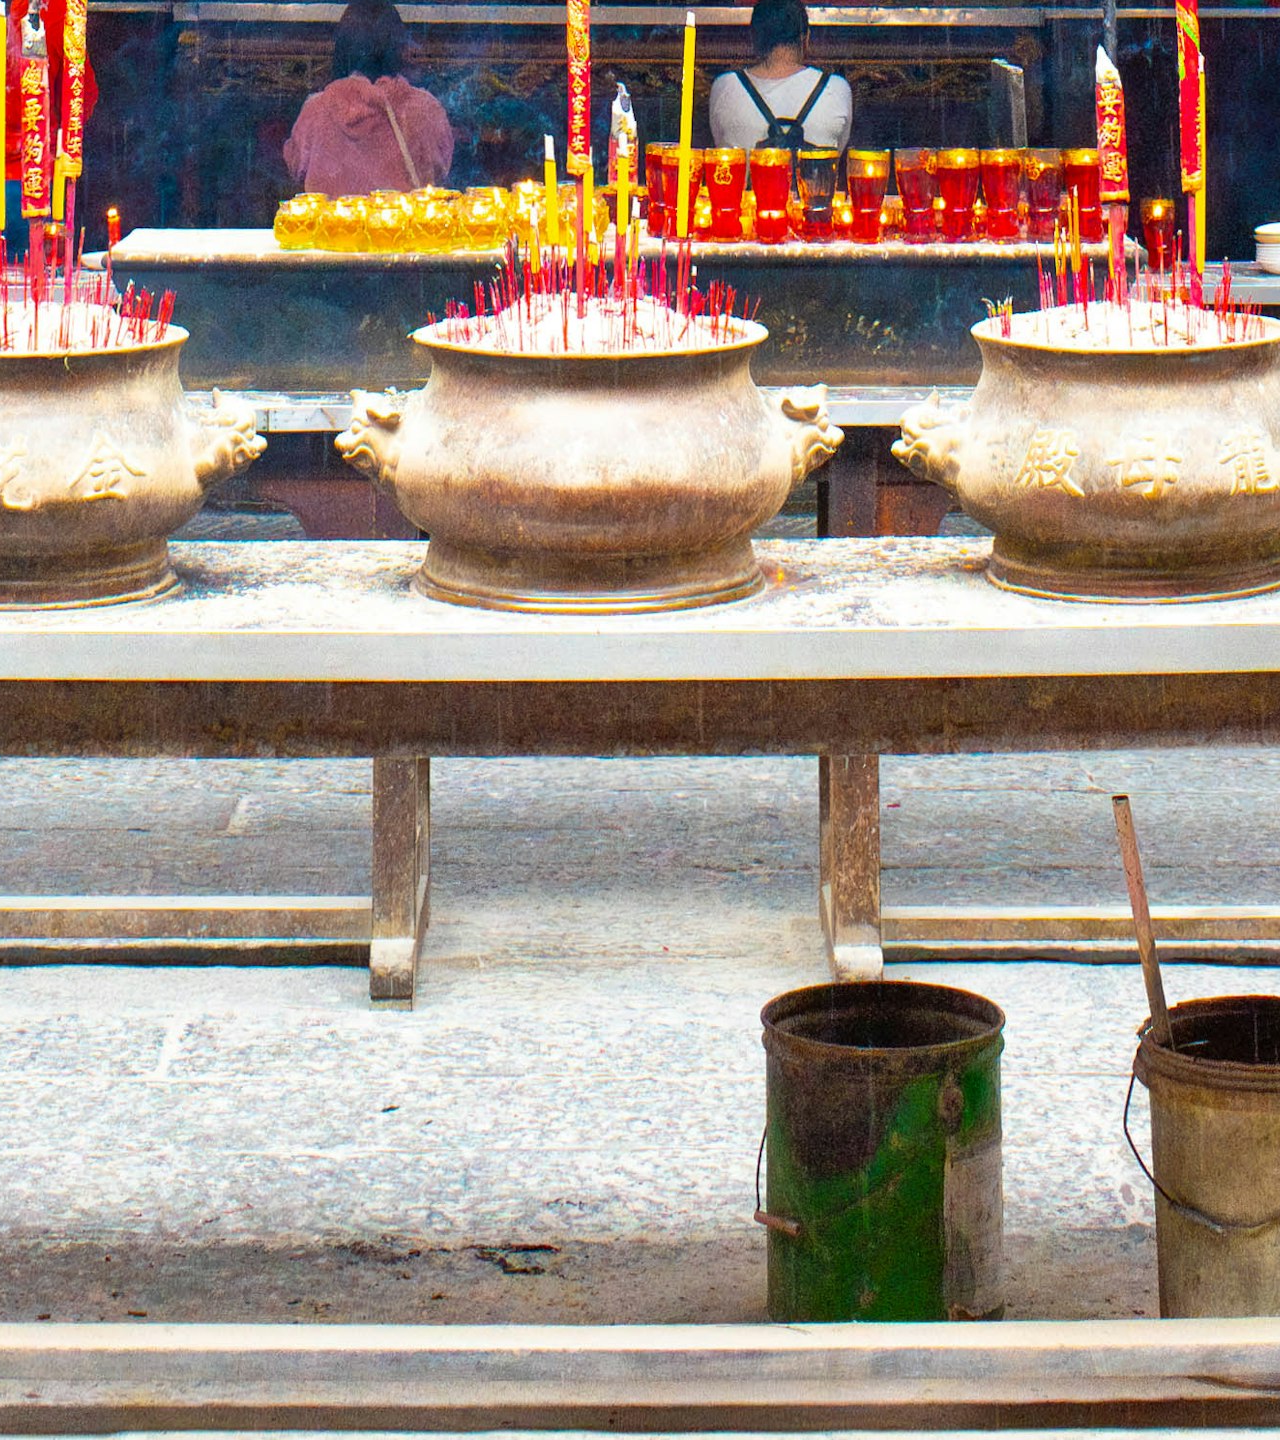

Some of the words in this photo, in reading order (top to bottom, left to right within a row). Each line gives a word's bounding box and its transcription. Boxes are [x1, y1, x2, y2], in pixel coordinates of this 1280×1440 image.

[65, 78, 85, 155] 合家平安
[570, 76, 587, 152] 合家平安
